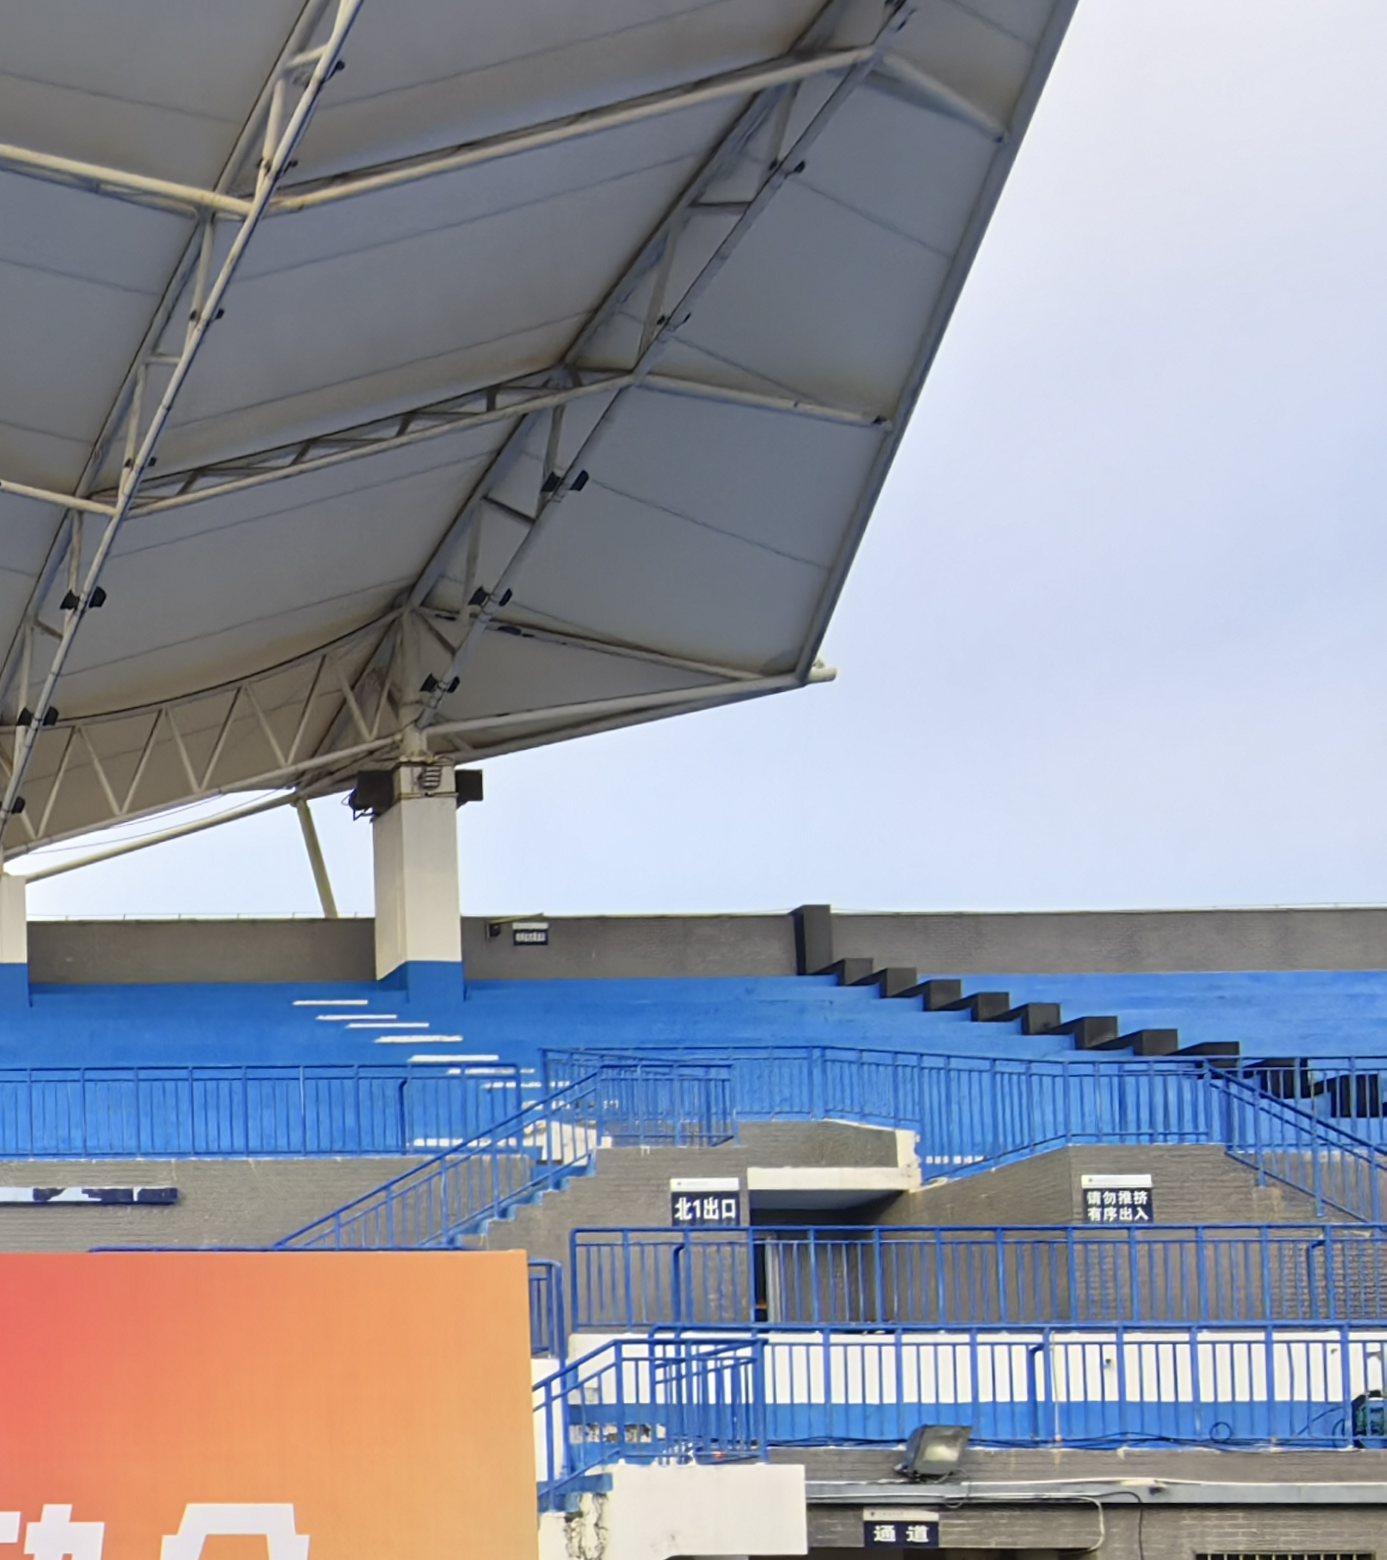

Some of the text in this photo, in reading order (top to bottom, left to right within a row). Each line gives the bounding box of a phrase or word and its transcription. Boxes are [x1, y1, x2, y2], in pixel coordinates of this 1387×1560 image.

[1087, 1190, 1148, 1206] 请勿推挤
[674, 1196, 736, 1220] 北1出口
[1087, 1206, 1149, 1221] 有序出入
